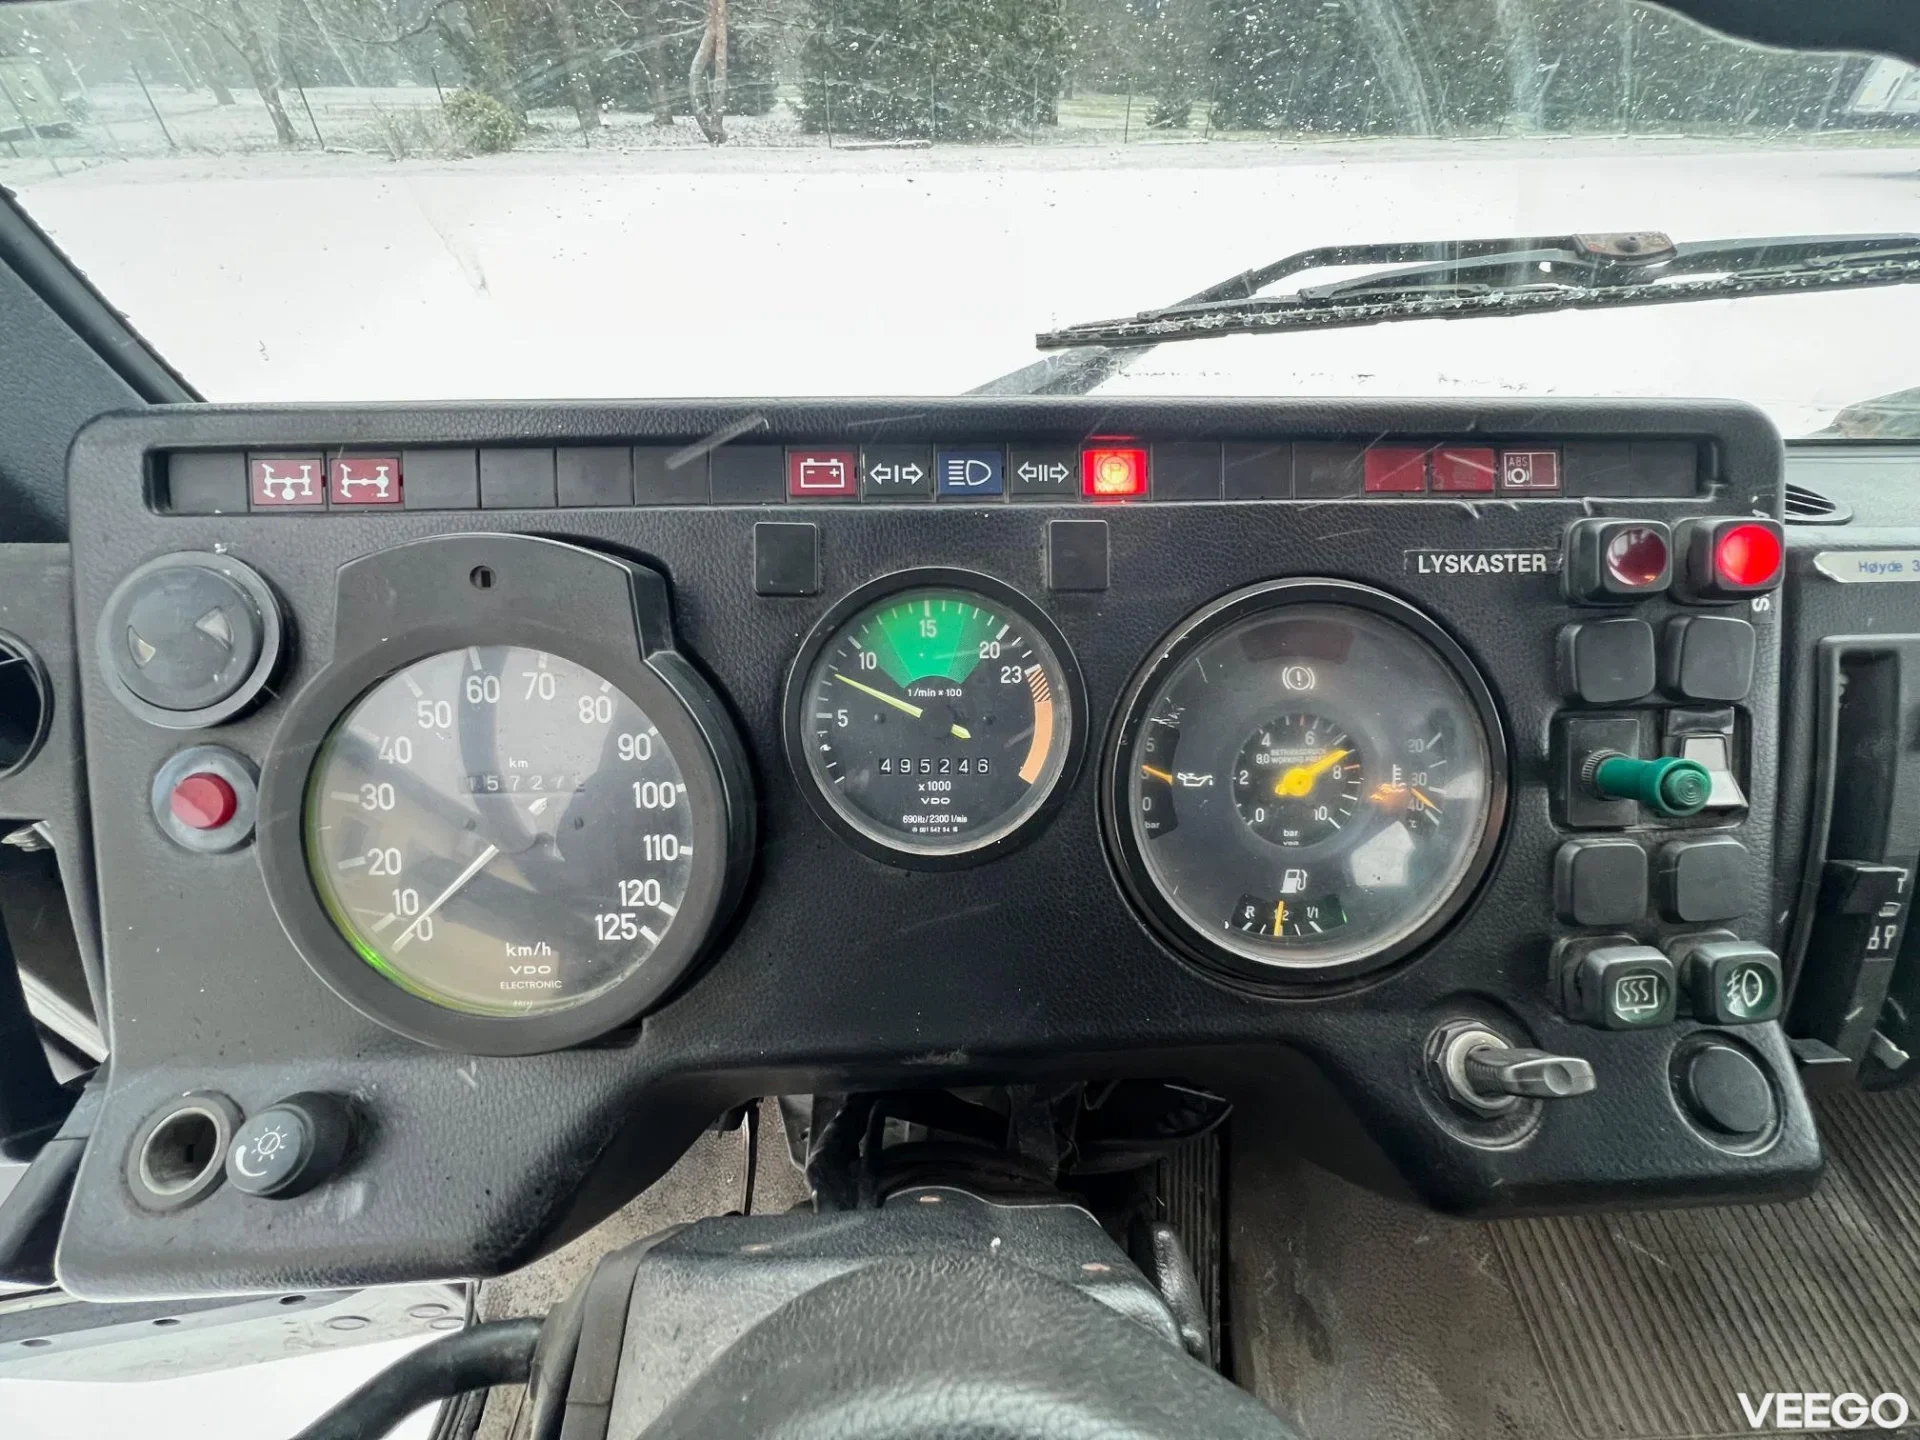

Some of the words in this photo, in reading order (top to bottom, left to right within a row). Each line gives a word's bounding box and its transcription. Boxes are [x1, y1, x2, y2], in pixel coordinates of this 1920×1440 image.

[1508, 457, 1528, 467] ABS
[1418, 553, 1547, 574] LYSKASTER
[1858, 560, 1903, 575] Høyde
[920, 619, 937, 638] 15
[979, 641, 1000, 659] 20
[859, 652, 877, 670] 10
[1001, 666, 1022, 684] 23
[466, 676, 500, 704] 60
[522, 672, 556, 700] 70
[417, 701, 452, 729] 50
[578, 696, 612, 724] 80
[837, 710, 849, 727] 5
[1145, 737, 1155, 752] 5
[1261, 733, 1271, 747] 4
[1305, 731, 1315, 745] 6
[379, 736, 413, 764] 40
[618, 733, 652, 761] 90
[508, 757, 529, 768] km
[1240, 770, 1249, 785] 2
[1332, 765, 1342, 780] 8
[927, 781, 952, 791] 1000
[360, 783, 395, 810] 30
[633, 781, 676, 809] 100
[920, 797, 951, 805] VDO
[1142, 796, 1152, 811] 0
[1255, 807, 1265, 822] 0
[1314, 806, 1328, 821] 10
[1144, 821, 1160, 829] bar
[1283, 829, 1299, 837] bar
[643, 834, 678, 862] 110
[368, 848, 402, 875] 20
[618, 879, 661, 907] 120
[392, 889, 419, 916] 10
[1245, 906, 1255, 918] R
[1306, 906, 1319, 919] 1/1
[417, 917, 433, 942] 0
[595, 913, 638, 940] 125
[506, 941, 551, 957] km/h
[509, 965, 552, 975] VDO
[500, 980, 563, 990] ELECTRONIC
